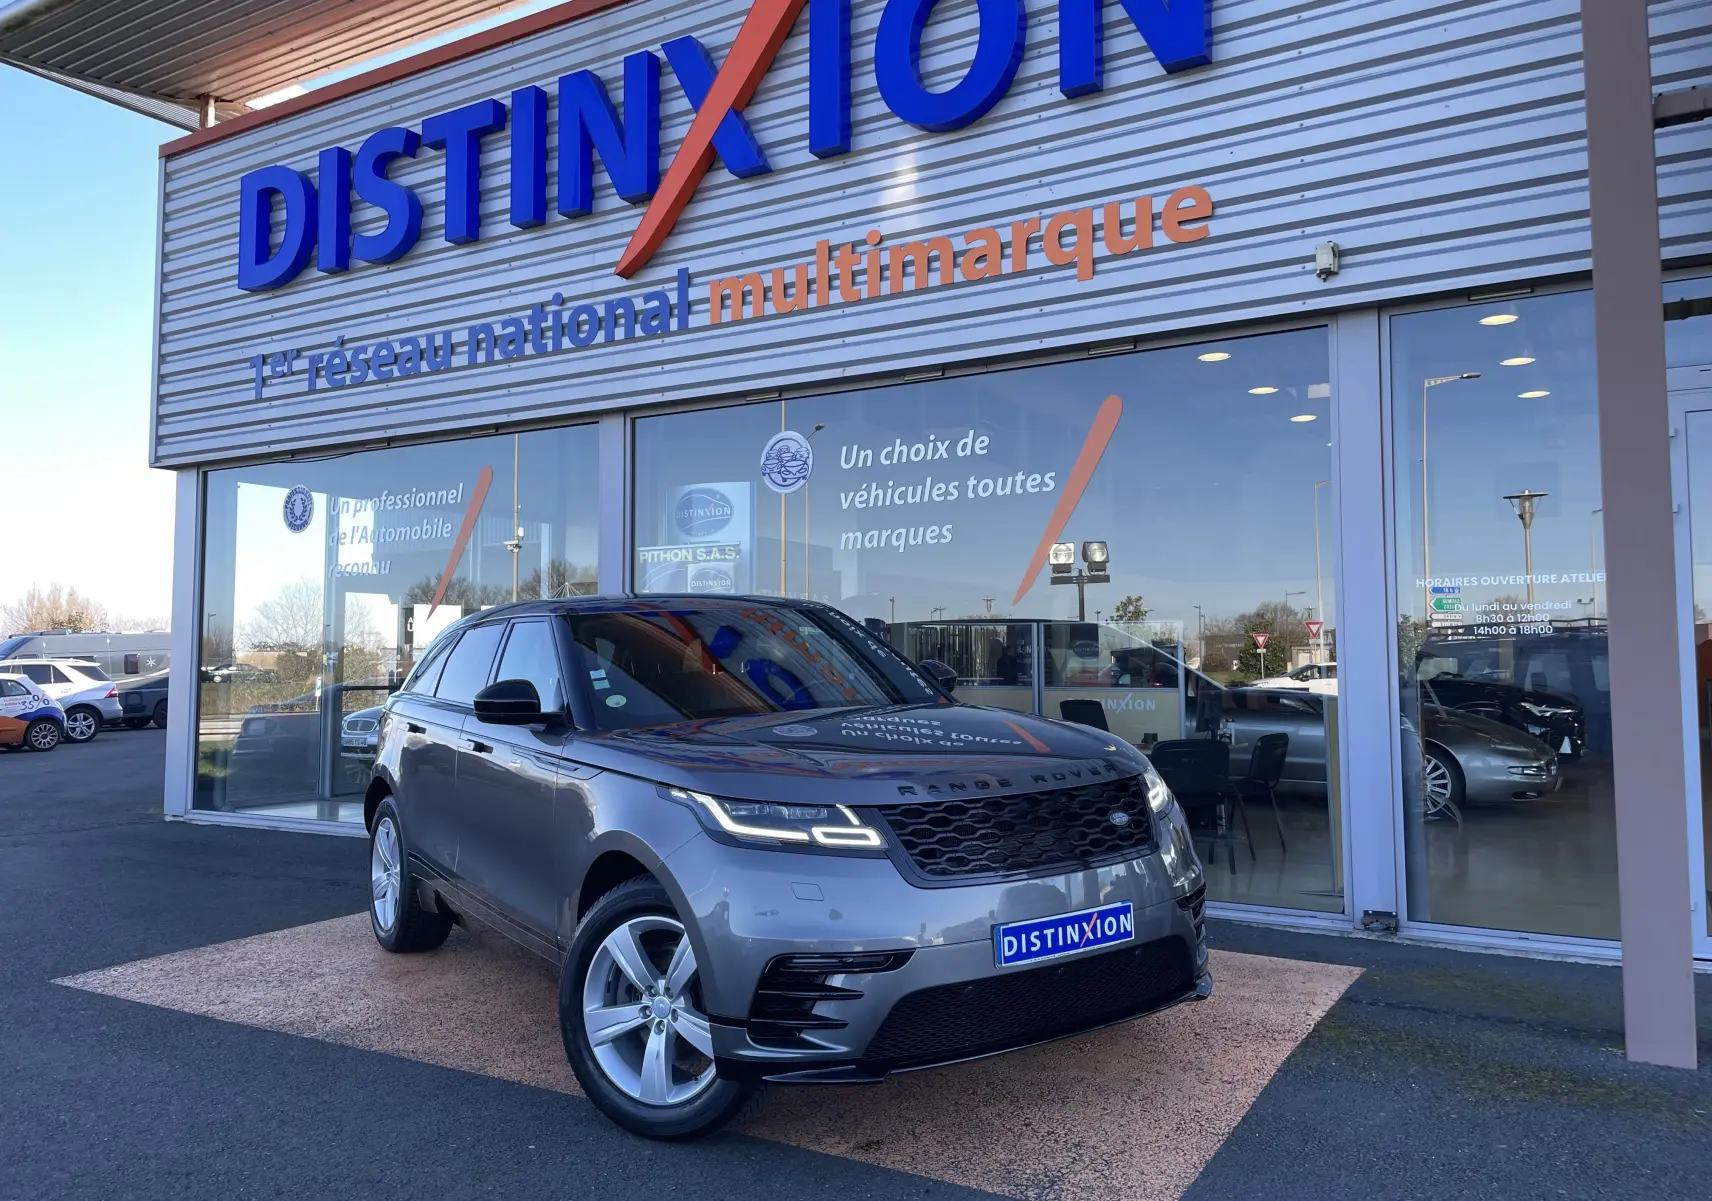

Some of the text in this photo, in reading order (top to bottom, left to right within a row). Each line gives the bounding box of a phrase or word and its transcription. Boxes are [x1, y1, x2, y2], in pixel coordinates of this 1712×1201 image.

[248, 185, 1214, 400] 1er réseau national multimarque
[841, 429, 990, 470] Un choix de
[330, 483, 464, 518] Un professionnel
[840, 470, 1056, 510] véhicules toutes
[329, 518, 452, 547] de l'Automobile
[840, 523, 953, 553] marques
[329, 560, 391, 578] reconnu
[639, 546, 739, 563] PITHON S.A.S.
[1416, 572, 1607, 588] HORAIRES OUVERTURE ATELIE
[1454, 603, 1468, 612] Du
[1472, 601, 1500, 612] lundi
[1503, 603, 1517, 611] au
[1520, 601, 1572, 611] vendredi
[1476, 613, 1550, 623] 8h30 à 12h00
[1473, 625, 1553, 635] 14h00 à 18h00
[897, 764, 1119, 796] RANGE ROVER
[1003, 912, 1132, 957] DISTINXION
